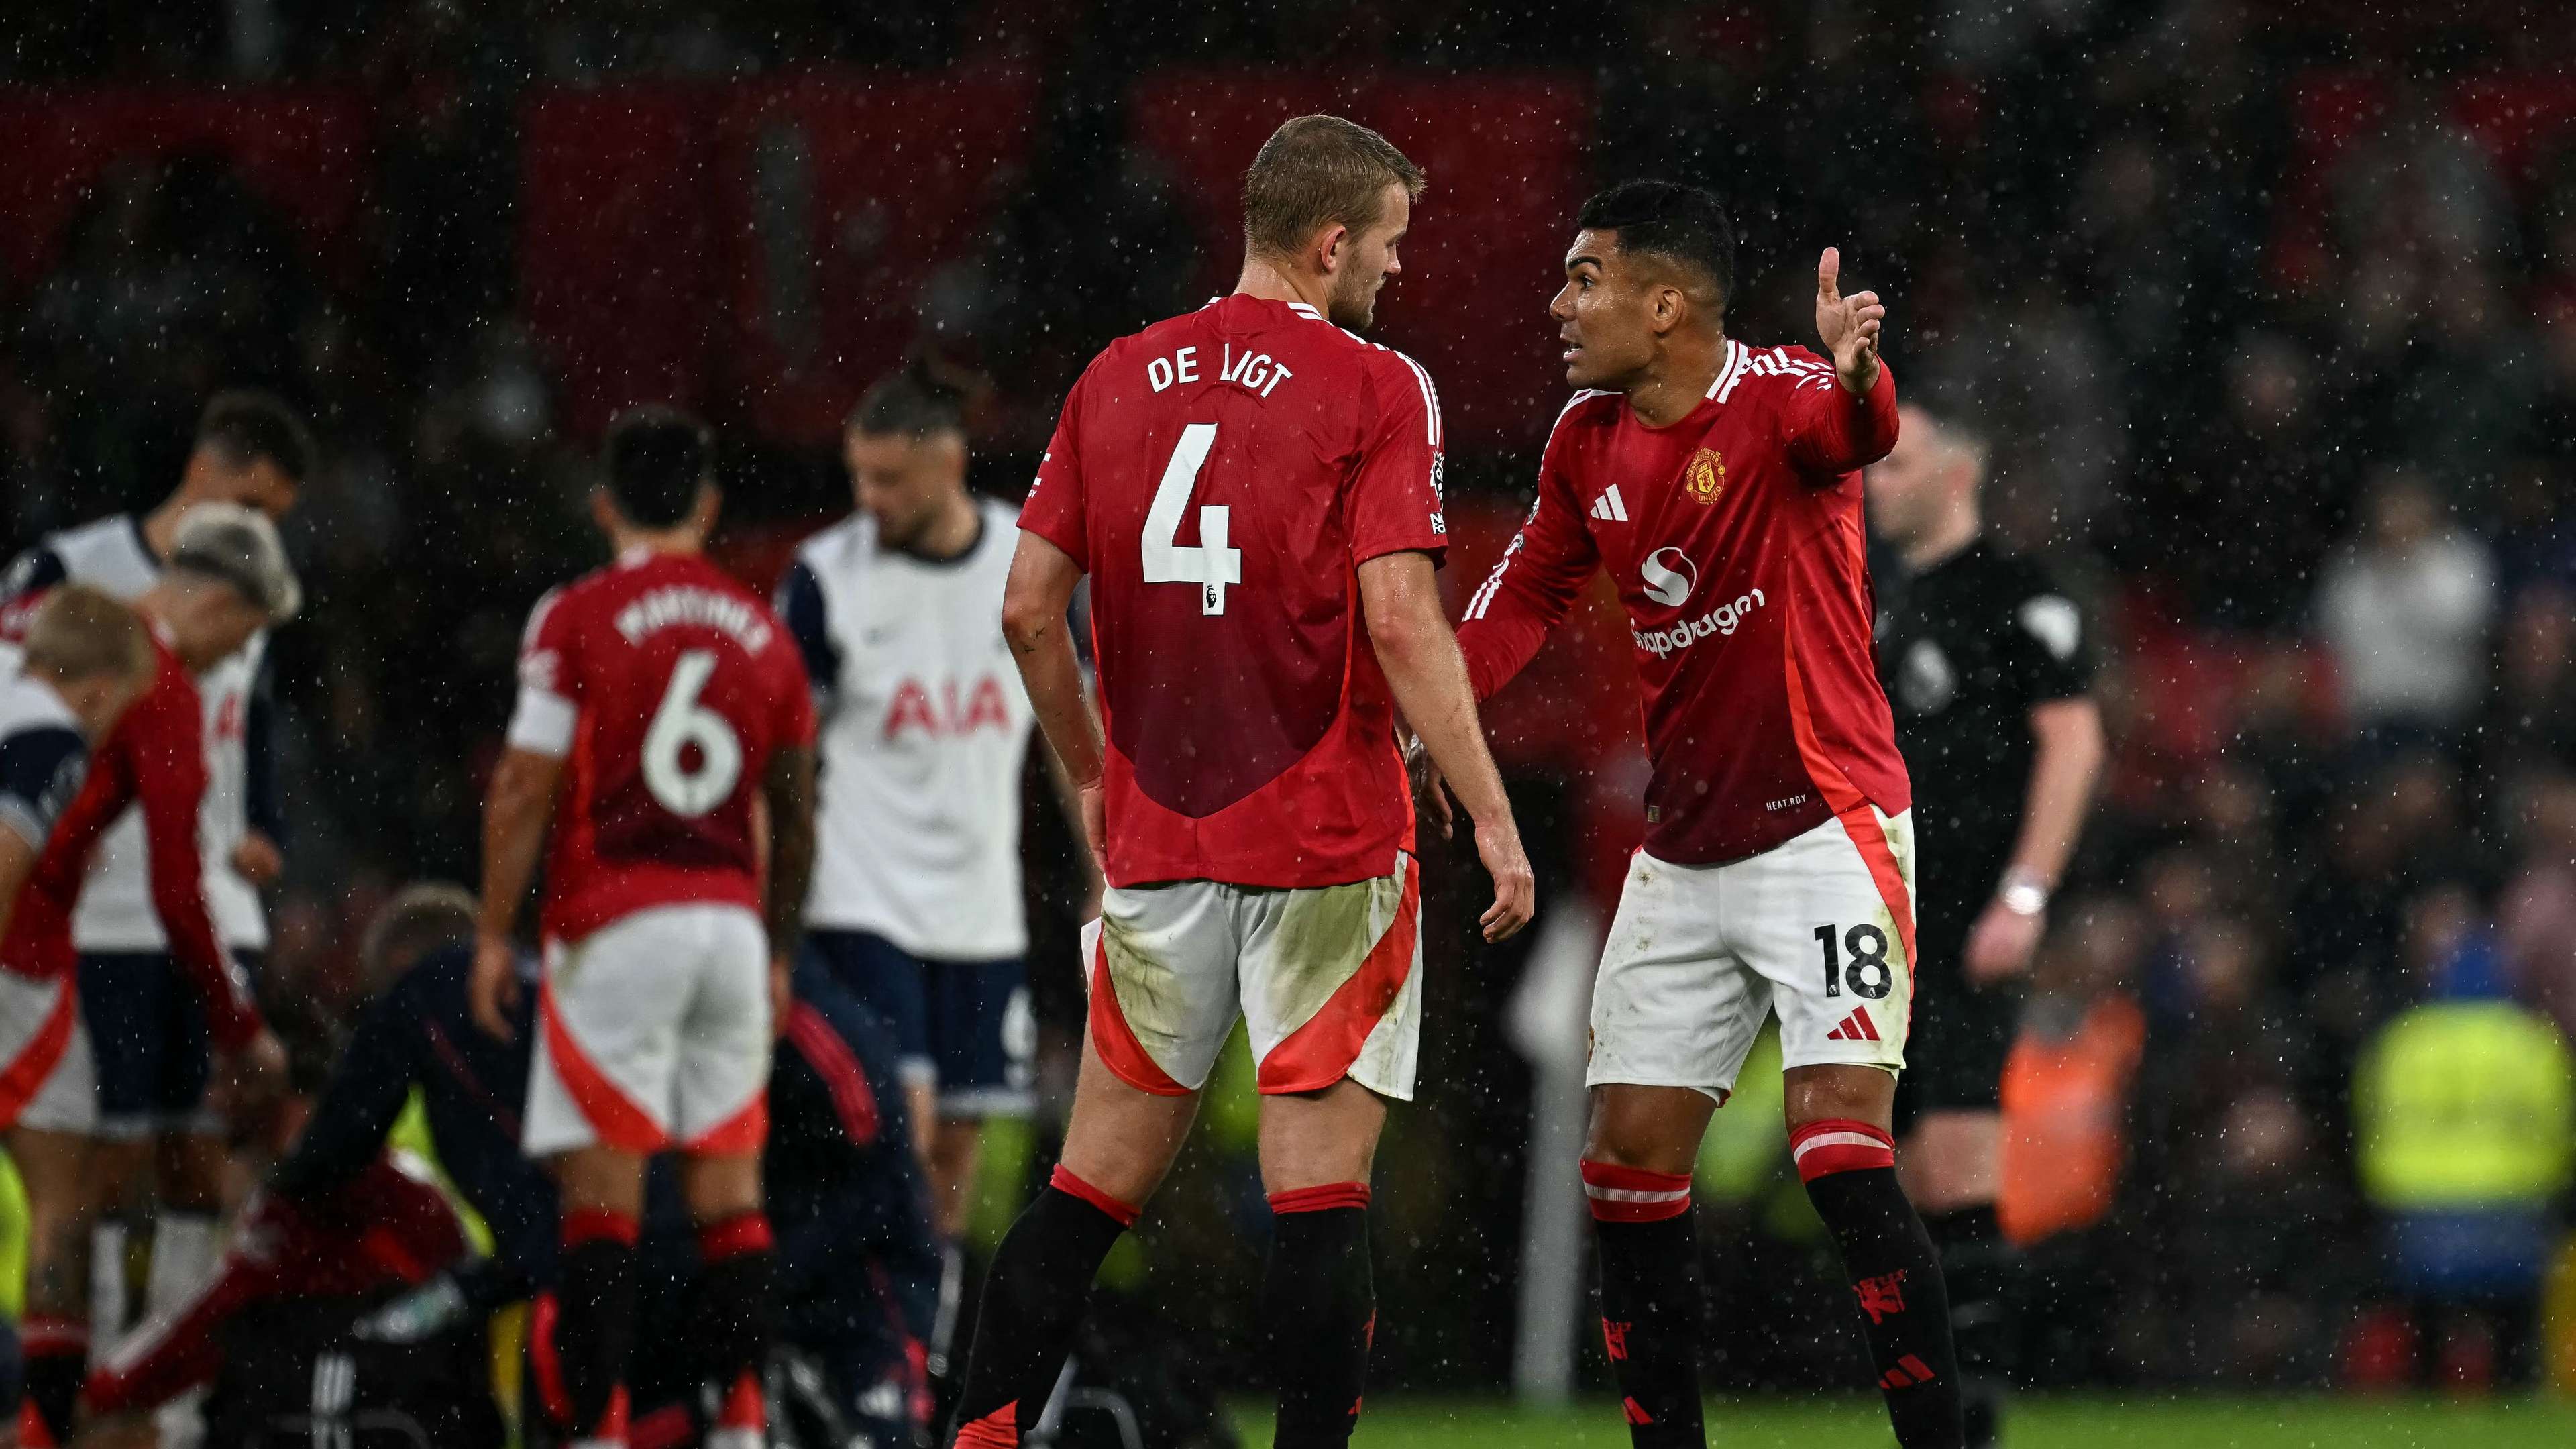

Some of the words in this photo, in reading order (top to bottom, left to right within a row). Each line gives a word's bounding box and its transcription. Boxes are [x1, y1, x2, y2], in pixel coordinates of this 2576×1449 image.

[1147, 345, 1199, 394] DE
[1220, 343, 1293, 398] LIGT
[1687, 451, 1719, 476] MANCHESTER
[1142, 423, 1241, 616] 4
[1699, 486, 1721, 502] UNITED
[642, 647, 743, 818] 6
[883, 676, 1012, 739] AIA
[1766, 794, 1805, 811] HEAT.RDY
[1814, 924, 1892, 1000] 18
